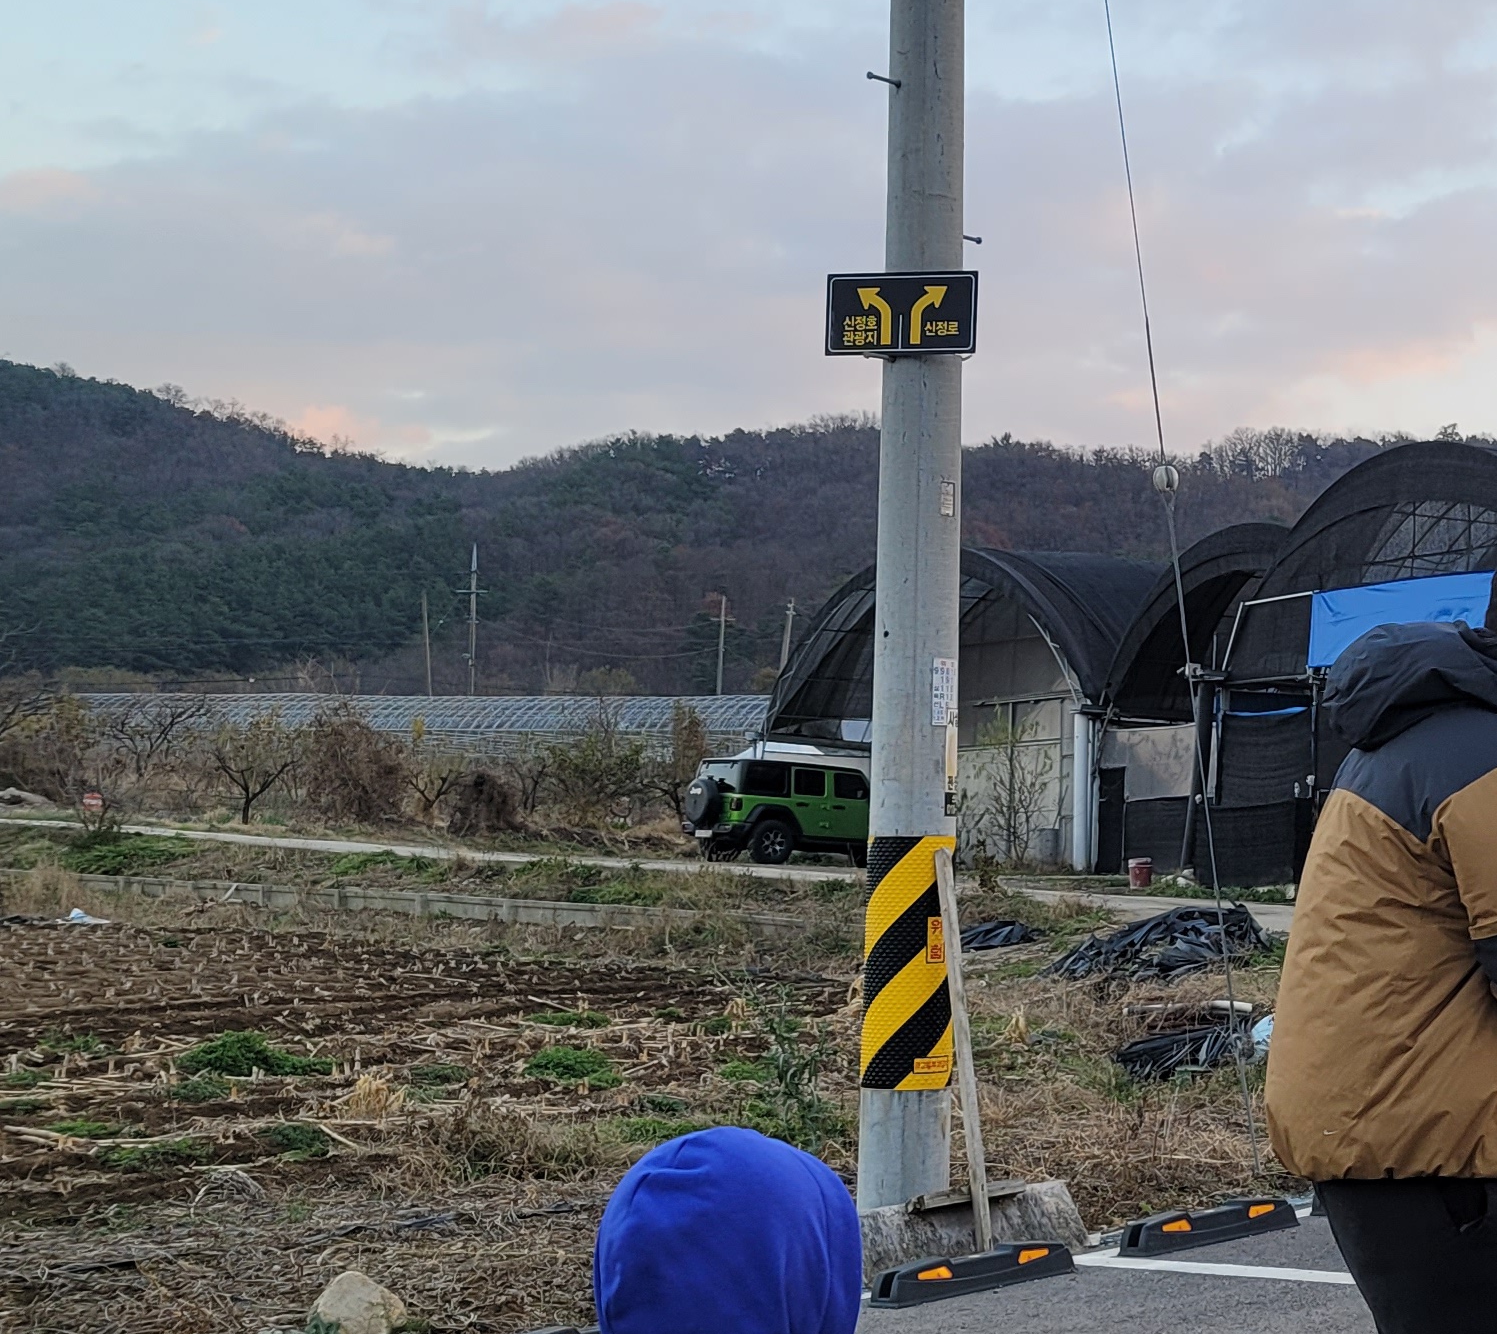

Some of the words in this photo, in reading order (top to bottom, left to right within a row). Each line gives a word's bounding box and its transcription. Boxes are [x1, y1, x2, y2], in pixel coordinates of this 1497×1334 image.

[843, 315, 878, 331] 신정호
[924, 320, 960, 336] 신정로
[842, 331, 878, 346] 관광지
